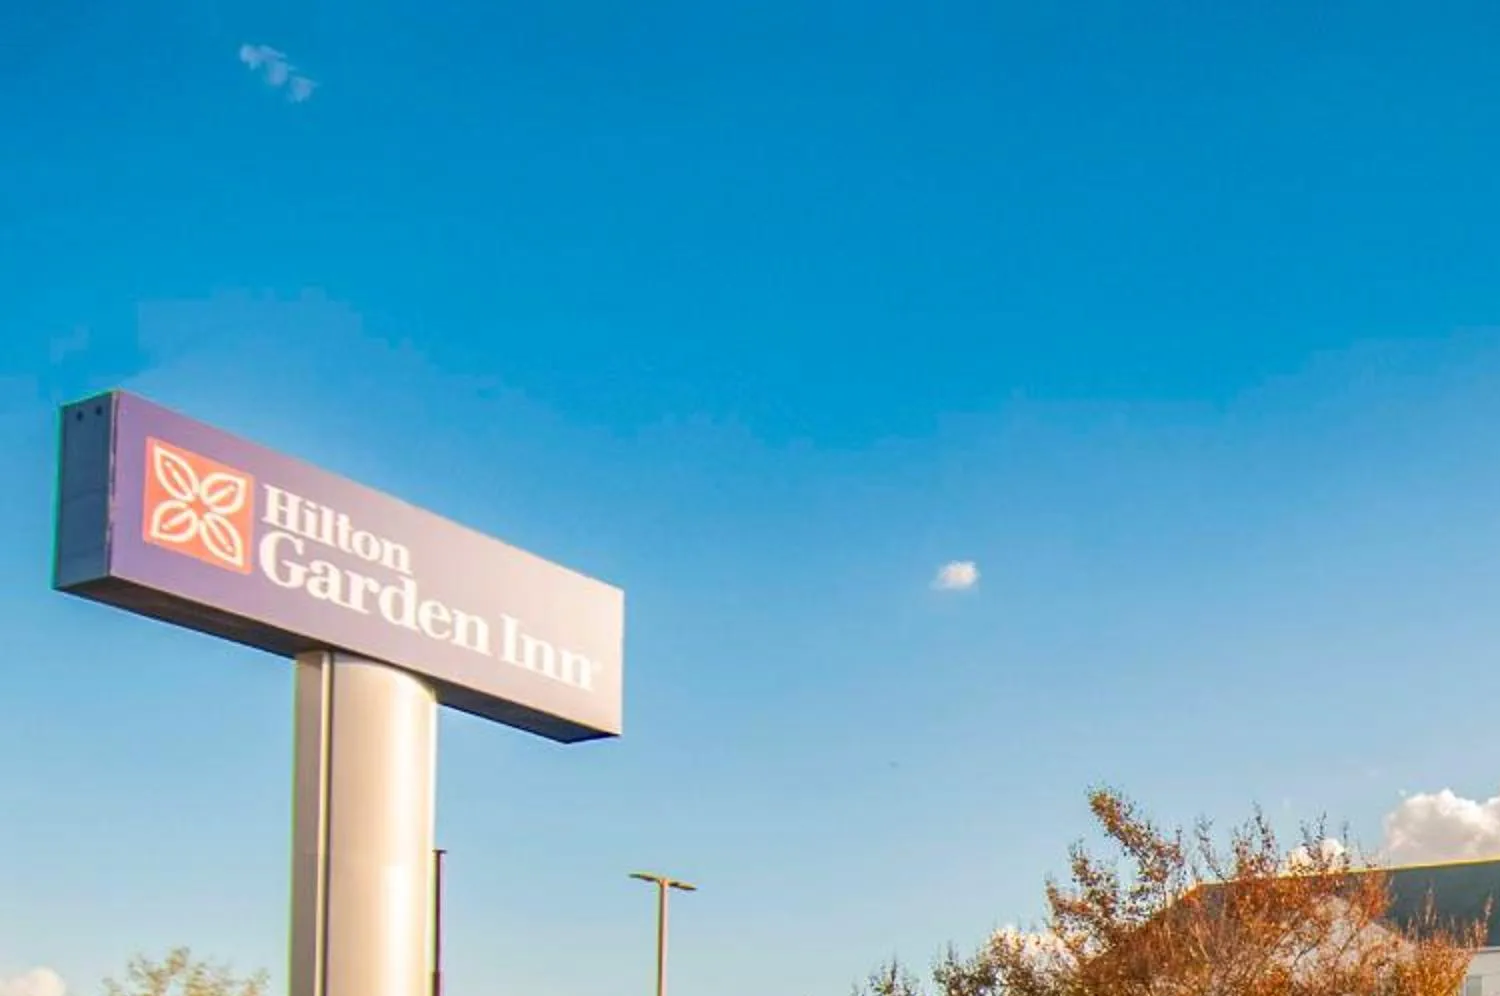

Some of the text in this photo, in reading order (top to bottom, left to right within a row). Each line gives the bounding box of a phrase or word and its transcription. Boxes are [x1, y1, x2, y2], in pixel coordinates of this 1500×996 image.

[261, 483, 413, 575] Hilton
[258, 530, 594, 691] Garden Inn
